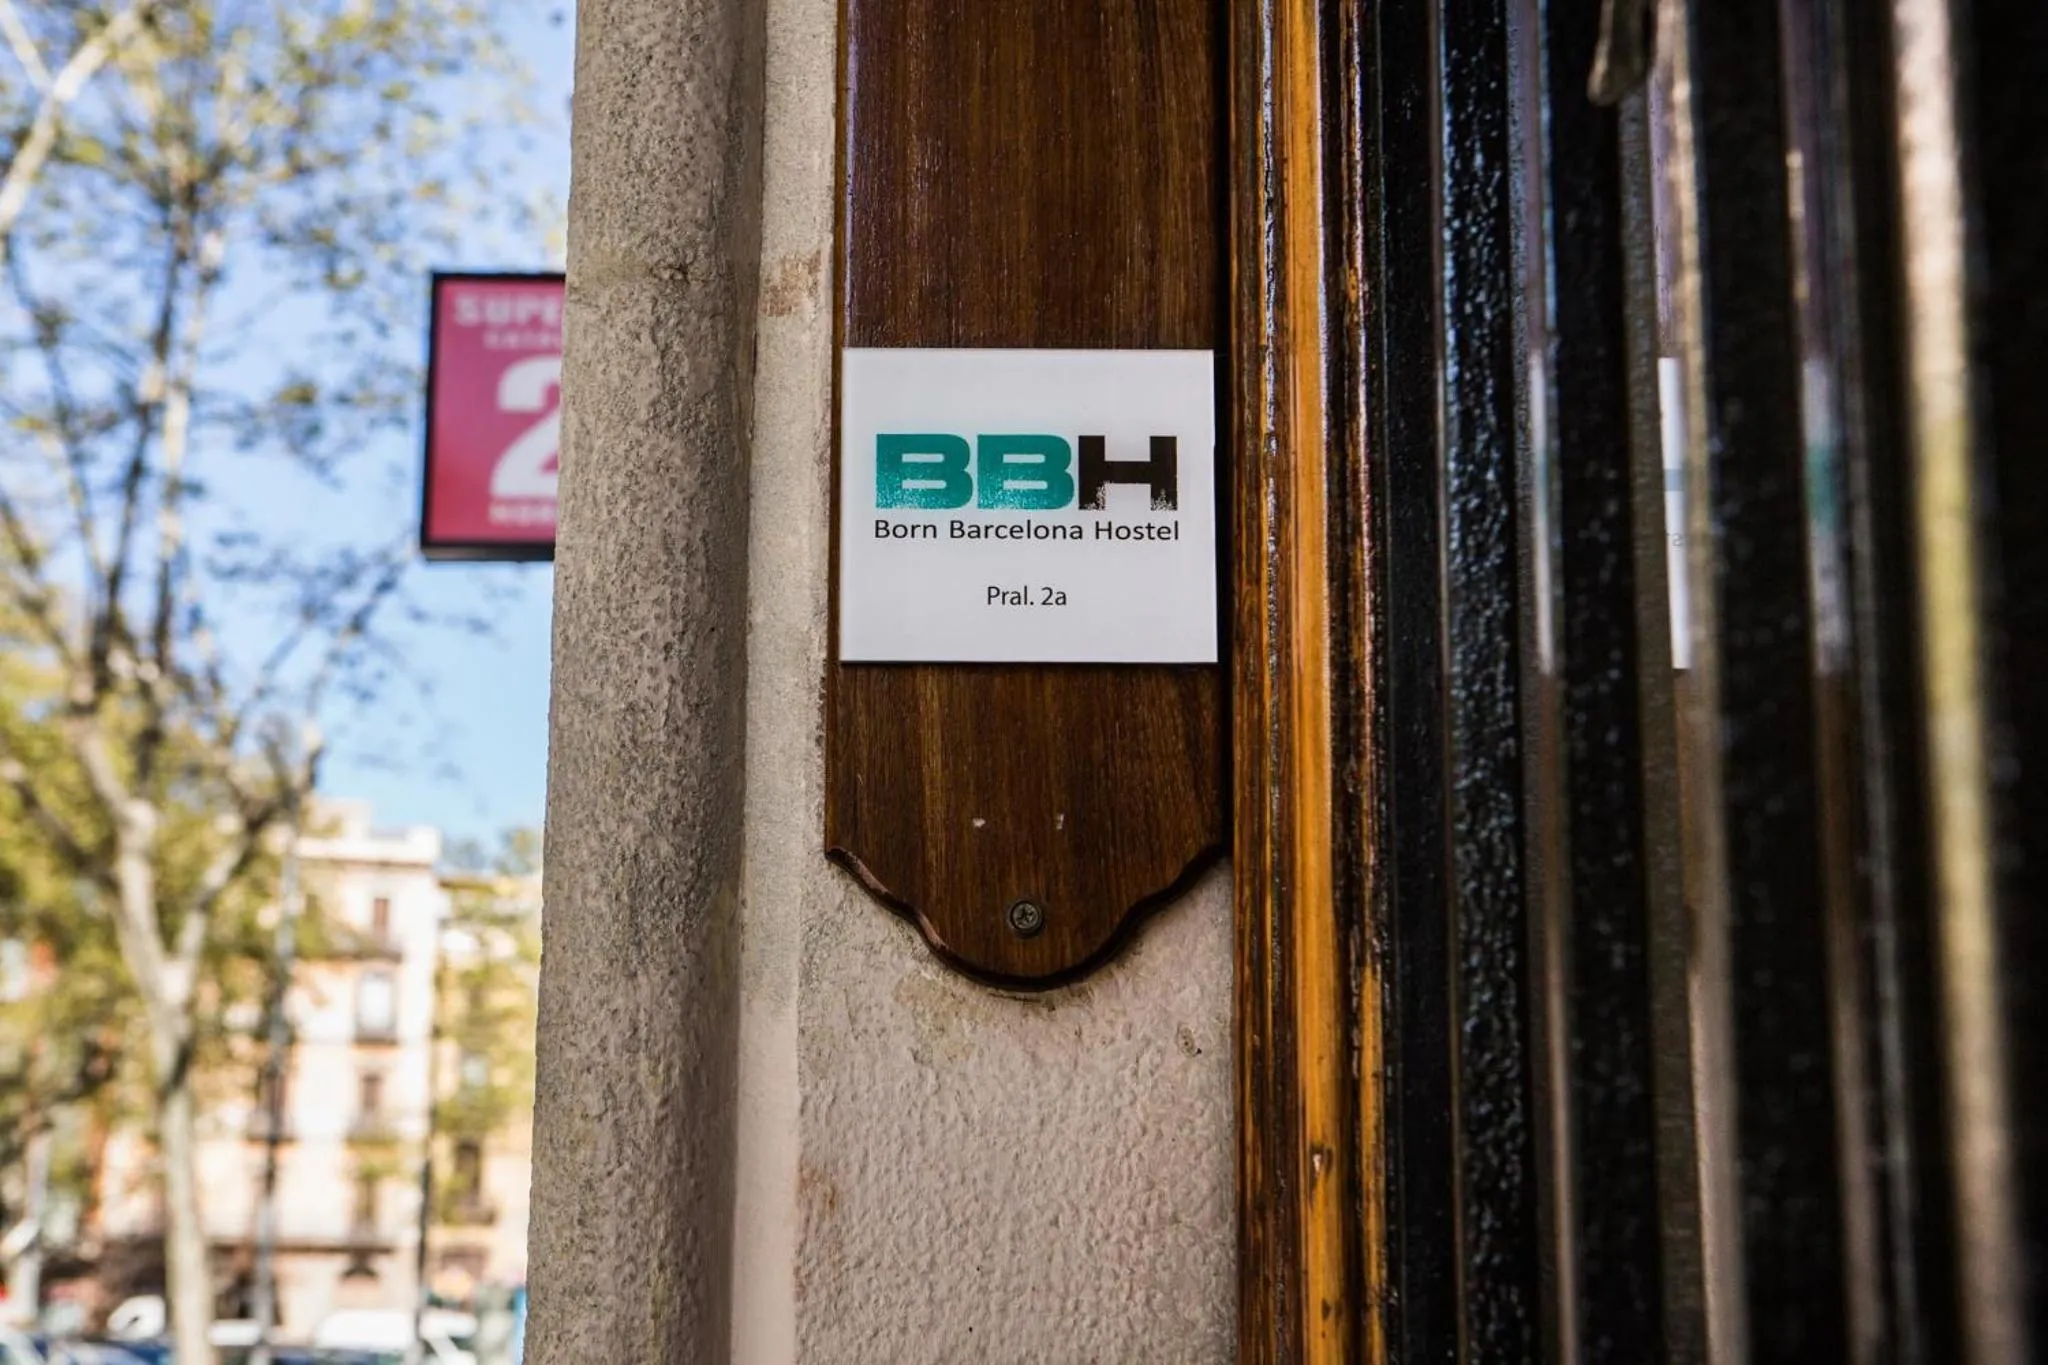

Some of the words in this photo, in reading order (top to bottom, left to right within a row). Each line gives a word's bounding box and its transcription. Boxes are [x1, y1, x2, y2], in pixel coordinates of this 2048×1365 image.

[876, 434, 1178, 511] BBH
[875, 519, 938, 539] Born
[949, 519, 1084, 540] Barcelona
[1094, 520, 1180, 541] Hostel
[987, 585, 1035, 606] Pral.
[1041, 587, 1067, 606] 2a
